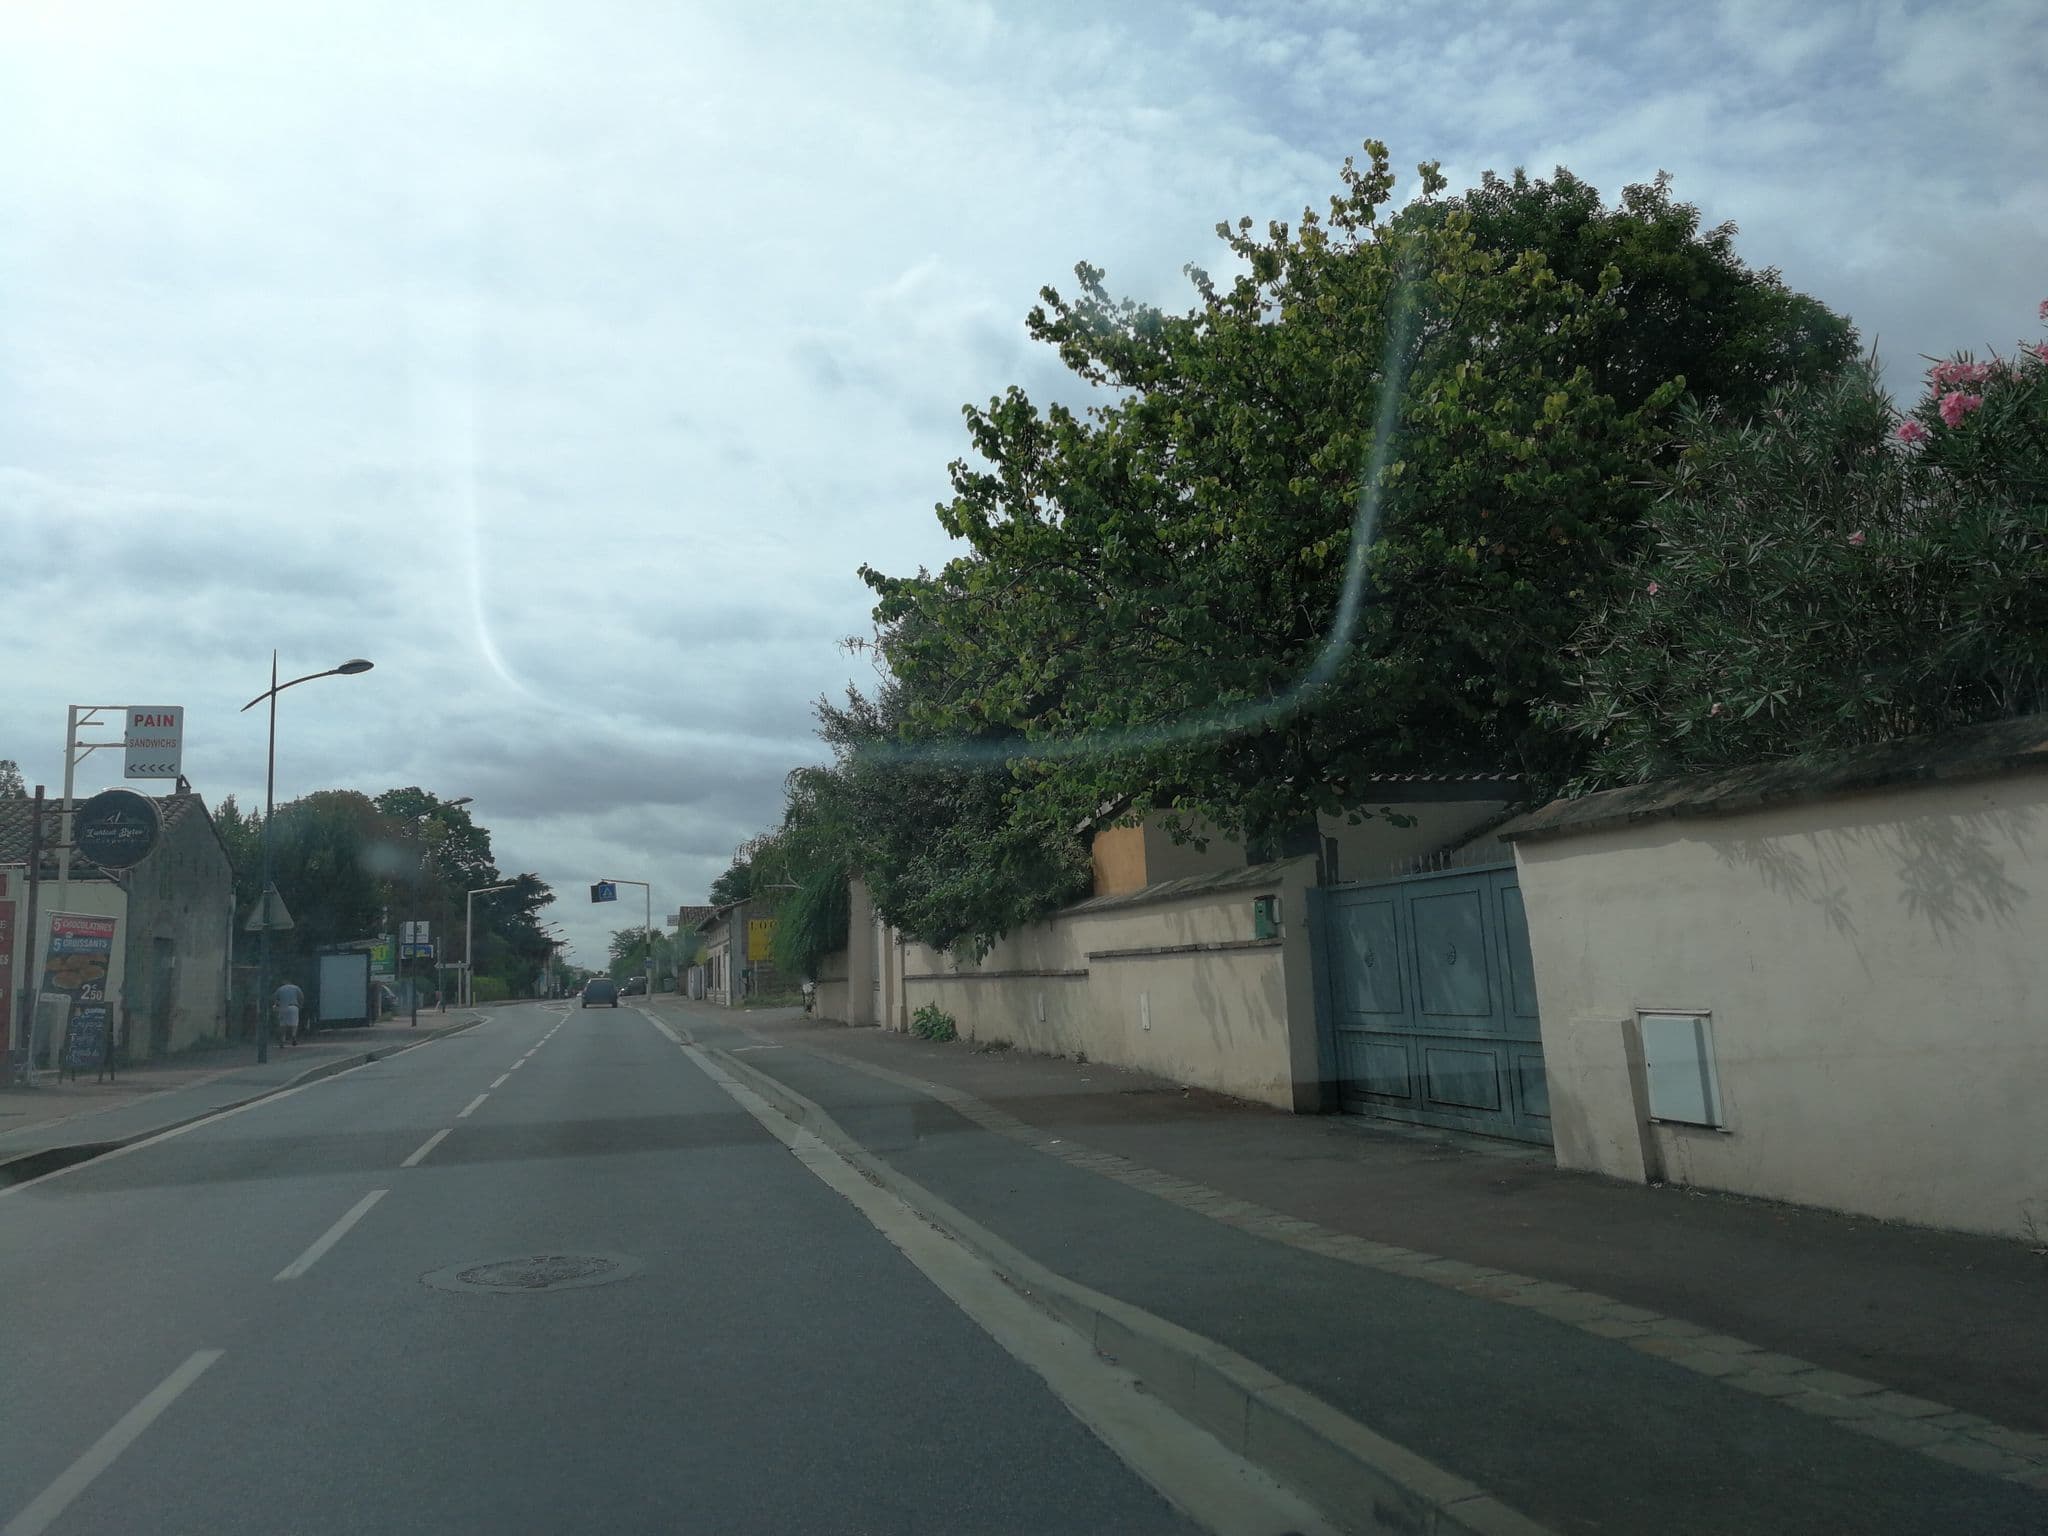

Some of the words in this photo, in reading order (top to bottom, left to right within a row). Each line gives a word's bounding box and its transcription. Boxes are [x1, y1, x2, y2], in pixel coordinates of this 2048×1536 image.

[134, 713, 175, 727] PAIN
[128, 738, 177, 748] SANDWICHS
[53, 917, 63, 931] 5
[53, 938, 62, 952] 5
